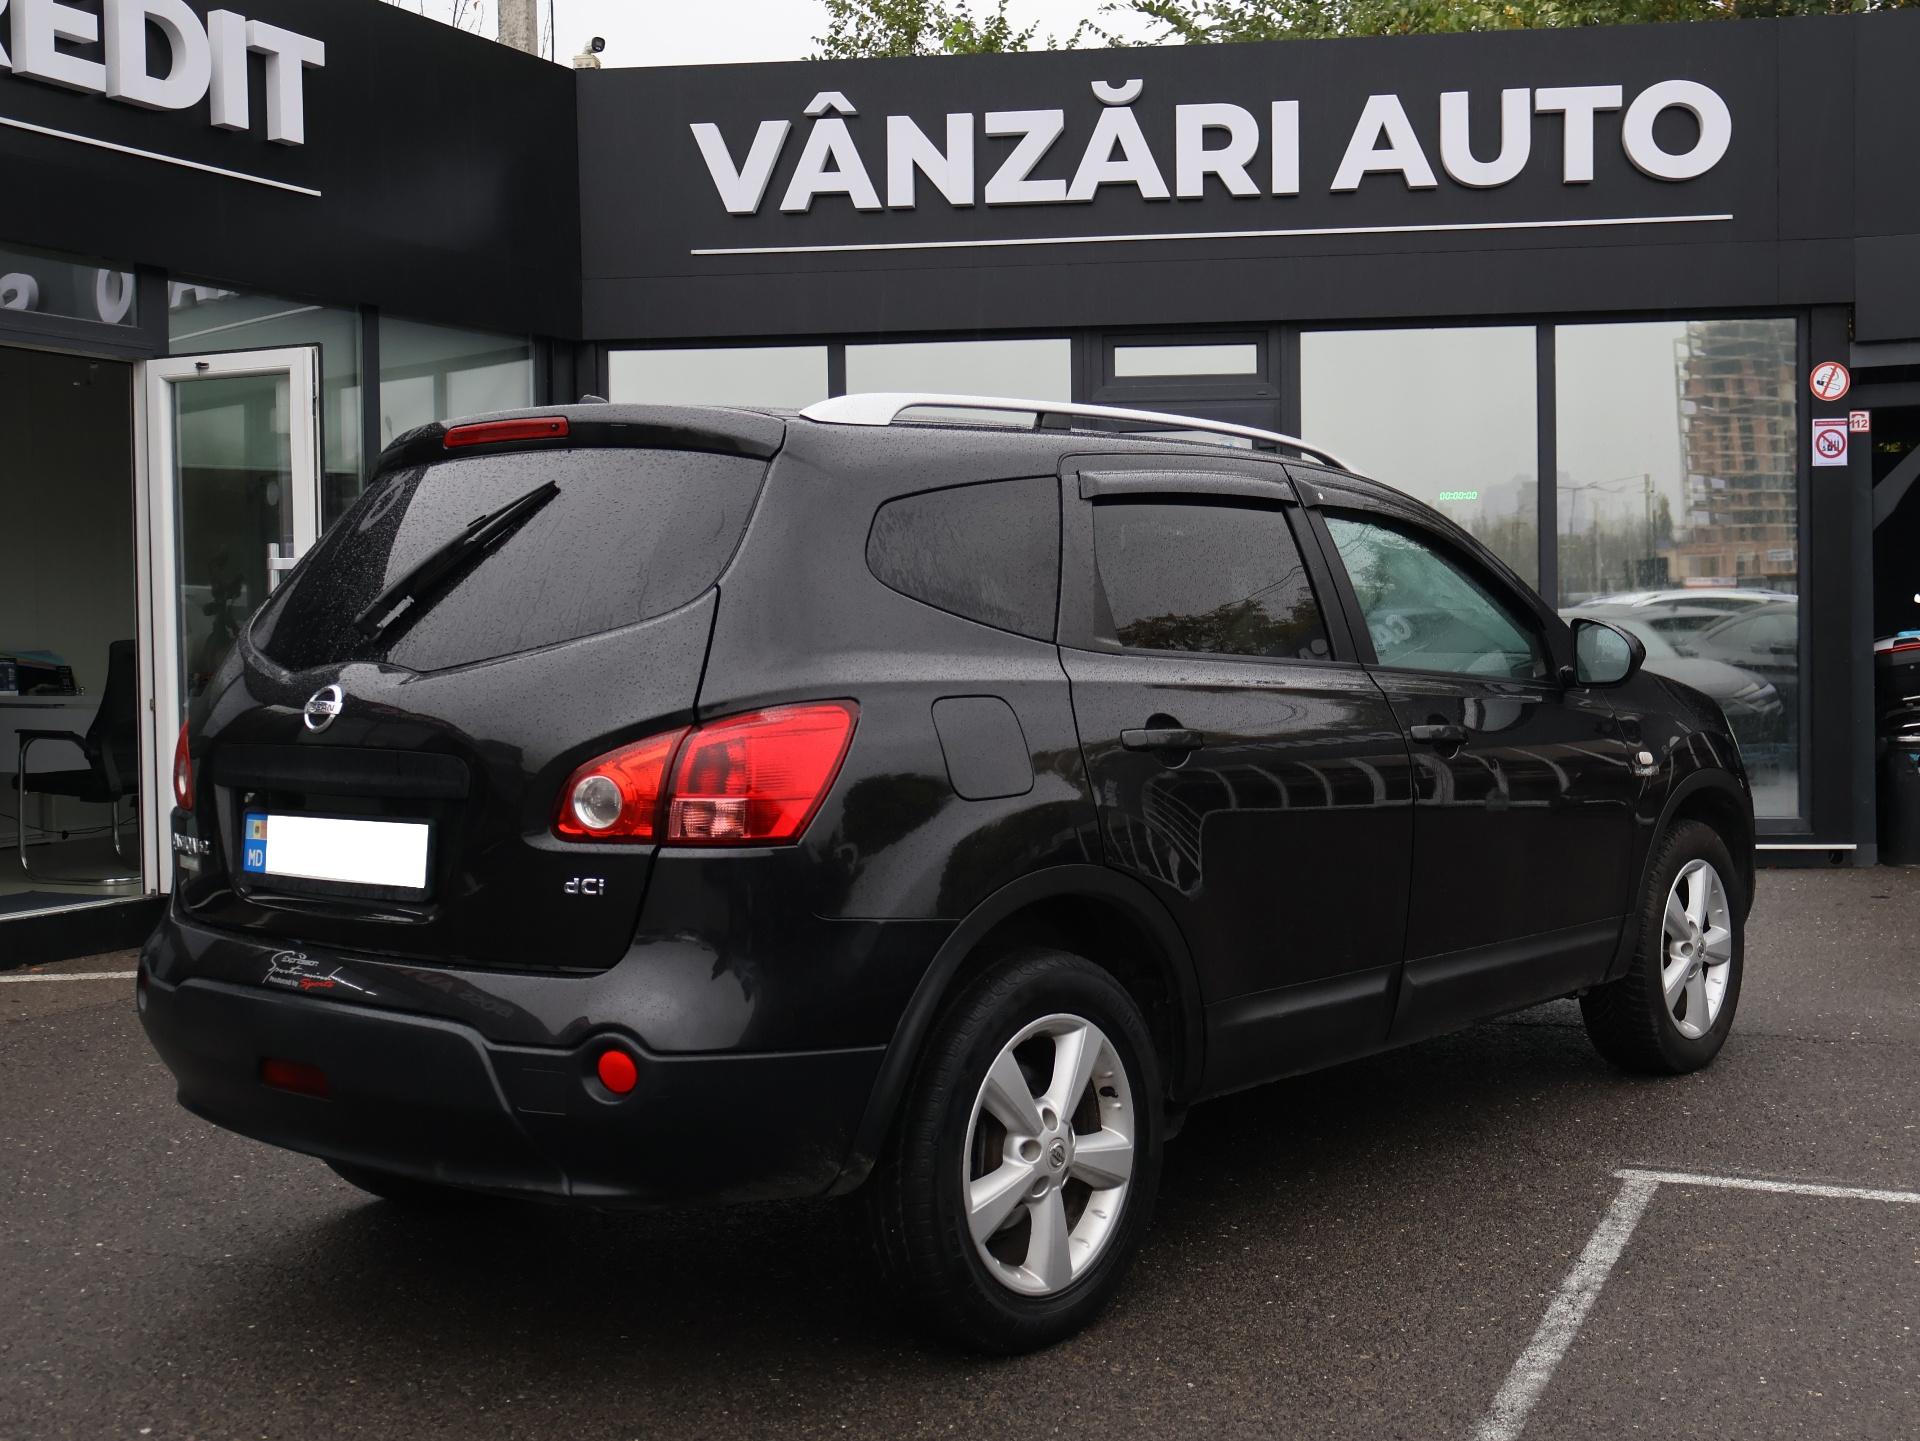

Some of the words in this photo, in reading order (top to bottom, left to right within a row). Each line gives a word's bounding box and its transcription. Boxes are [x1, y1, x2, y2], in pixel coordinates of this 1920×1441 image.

[0, 0, 325, 146] EDIT
[690, 79, 1300, 214] VÂNZĂRI
[1330, 79, 1732, 192] AUTO
[1850, 419, 1868, 429] 112
[247, 848, 264, 867] MD
[563, 877, 605, 896] dCi
